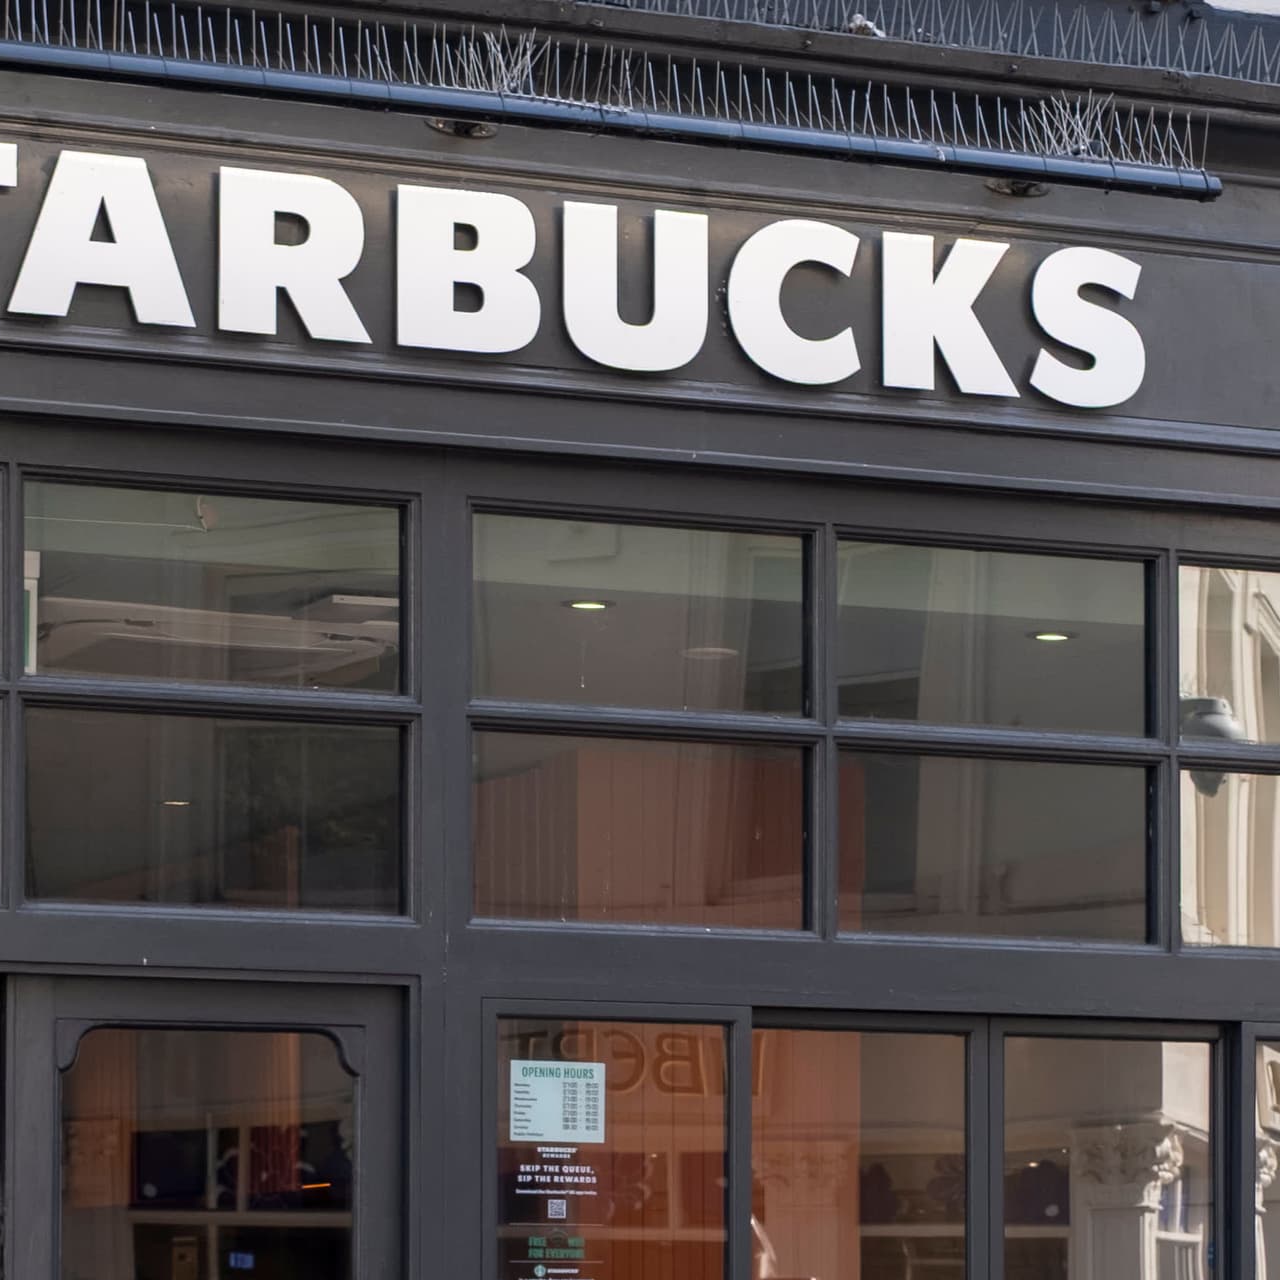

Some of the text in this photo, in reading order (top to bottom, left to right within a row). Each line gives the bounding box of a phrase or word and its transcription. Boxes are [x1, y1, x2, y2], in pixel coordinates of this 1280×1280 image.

[521, 1066, 594, 1079] OPENING HOURS
[520, 1164, 541, 1172] SKIP
[543, 1164, 559, 1173] THE
[534, 1175, 551, 1183] THE
[553, 1176, 597, 1184] REWARDS
